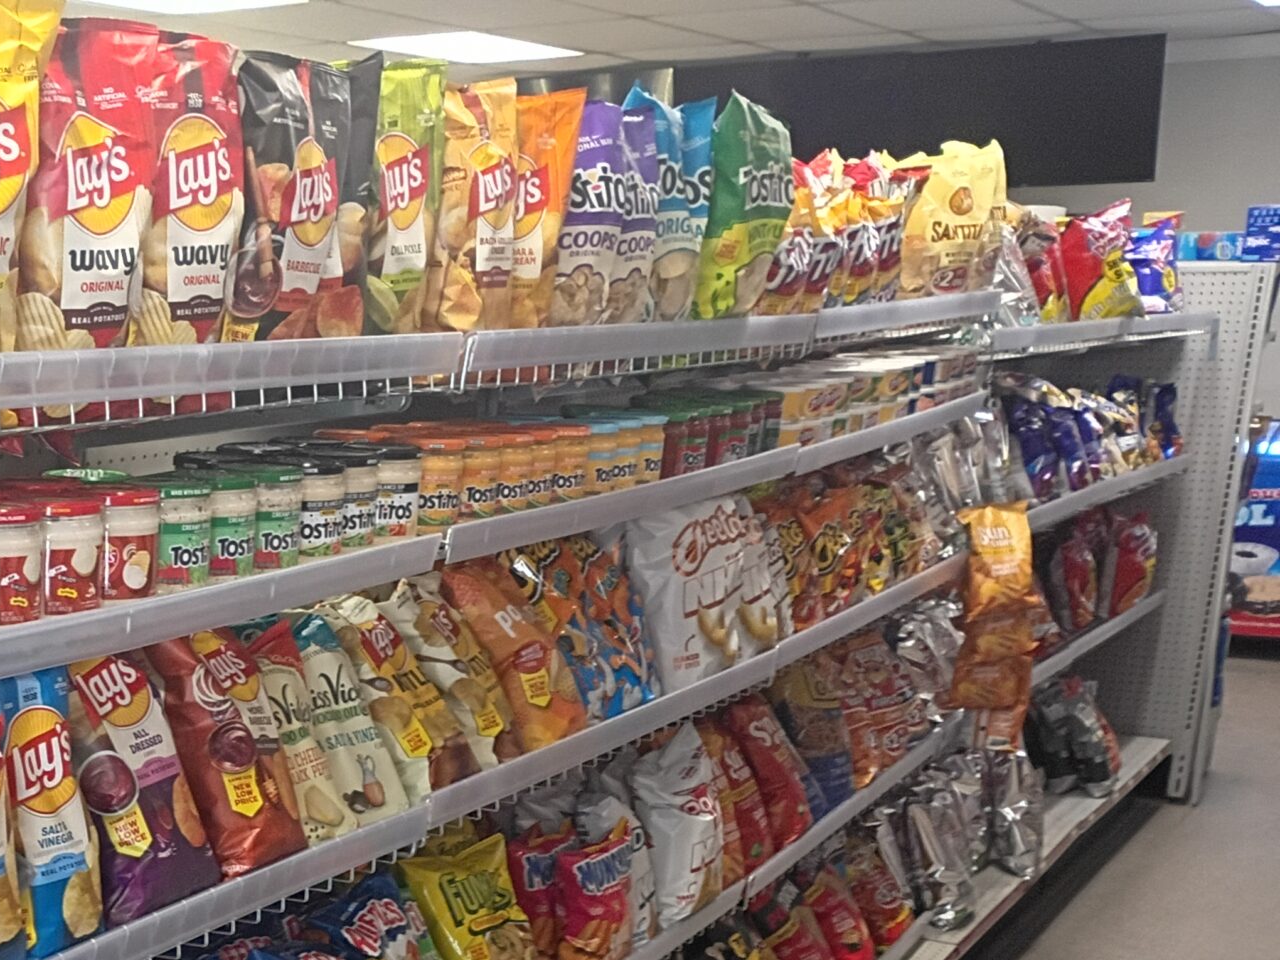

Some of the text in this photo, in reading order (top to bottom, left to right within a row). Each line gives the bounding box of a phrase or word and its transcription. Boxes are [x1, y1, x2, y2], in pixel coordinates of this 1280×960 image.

[67, 136, 130, 211] Lay's
[168, 136, 232, 211] Lay's
[69, 247, 135, 275] wavy
[172, 243, 230, 270] wavy
[80, 280, 124, 293] ORIGINAL
[183, 275, 221, 286] ORIGINAL
[71, 312, 125, 324] REAL POTATOES
[176, 308, 190, 317] REAL
[203, 645, 247, 689] Lay's
[75, 655, 138, 717] Lay's
[133, 729, 149, 740] ALL
[130, 735, 163, 754] DRESSED
[13, 724, 71, 805] Lay's
[234, 781, 251, 793] NEW
[236, 788, 253, 799] LOW
[41, 825, 61, 838] SALT
[37, 831, 74, 849] VINEGAR
[41, 868, 56, 878] REAL
